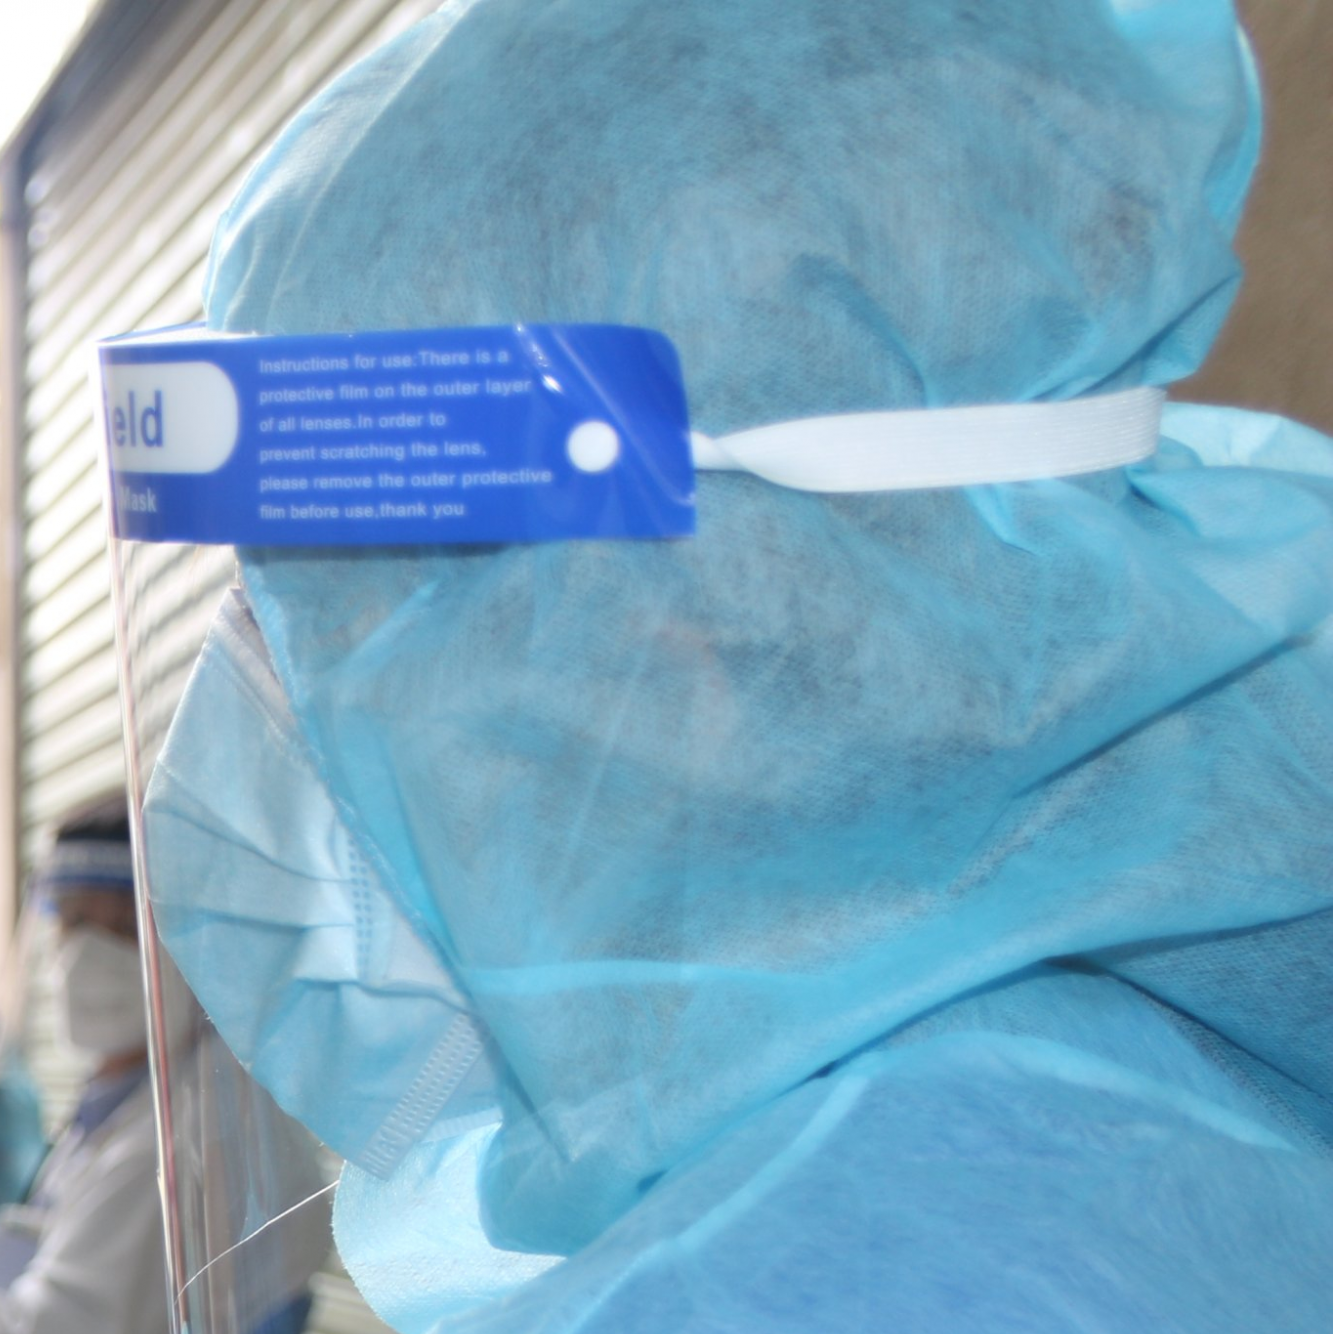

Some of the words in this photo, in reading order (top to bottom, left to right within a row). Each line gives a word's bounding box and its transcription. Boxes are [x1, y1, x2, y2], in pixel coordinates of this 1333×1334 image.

[259, 356, 349, 374] Instructions
[354, 354, 377, 369] for
[475, 349, 491, 364] is
[497, 351, 509, 364] a
[259, 386, 334, 405] protective
[339, 384, 369, 399] film
[374, 385, 395, 398] on
[400, 382, 428, 397] the
[434, 381, 480, 396] outer
[485, 379, 532, 396] layer
[259, 417, 274, 432] of
[278, 417, 296, 431] all
[379, 413, 424, 428] order
[429, 412, 446, 426] to
[259, 446, 316, 464] prevent
[320, 444, 405, 462] scratching
[411, 443, 438, 457] the
[259, 476, 308, 494] please
[313, 476, 373, 489] remove
[378, 472, 406, 488] the
[410, 472, 456, 487] outer
[462, 467, 553, 489] protective
[259, 504, 286, 519] film
[290, 503, 339, 519] before
[433, 503, 465, 519] you
